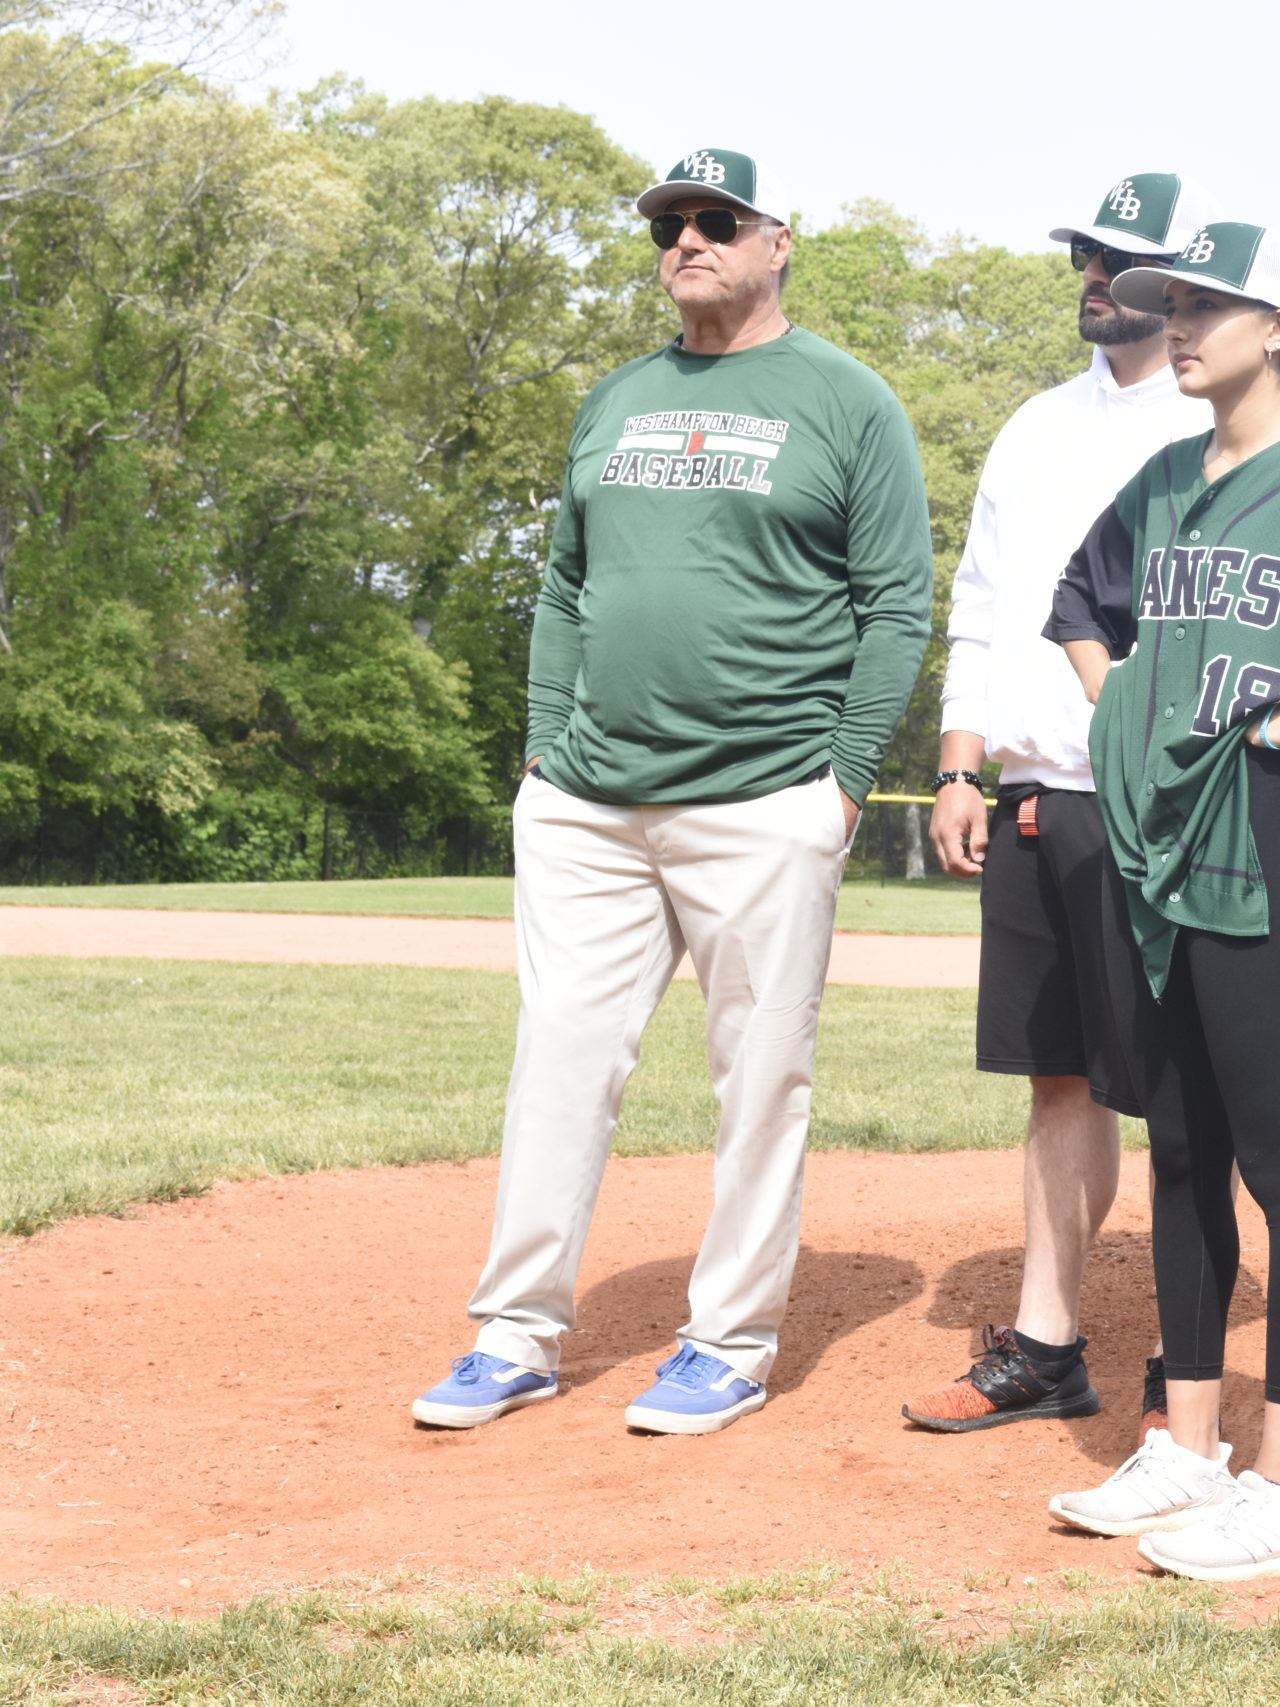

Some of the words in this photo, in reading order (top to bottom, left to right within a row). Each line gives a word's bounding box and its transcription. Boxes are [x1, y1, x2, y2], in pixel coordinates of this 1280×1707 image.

[624, 411, 733, 435] WESTHAMPTON
[731, 414, 789, 442] BEACH
[600, 452, 772, 495] BASEBALL
